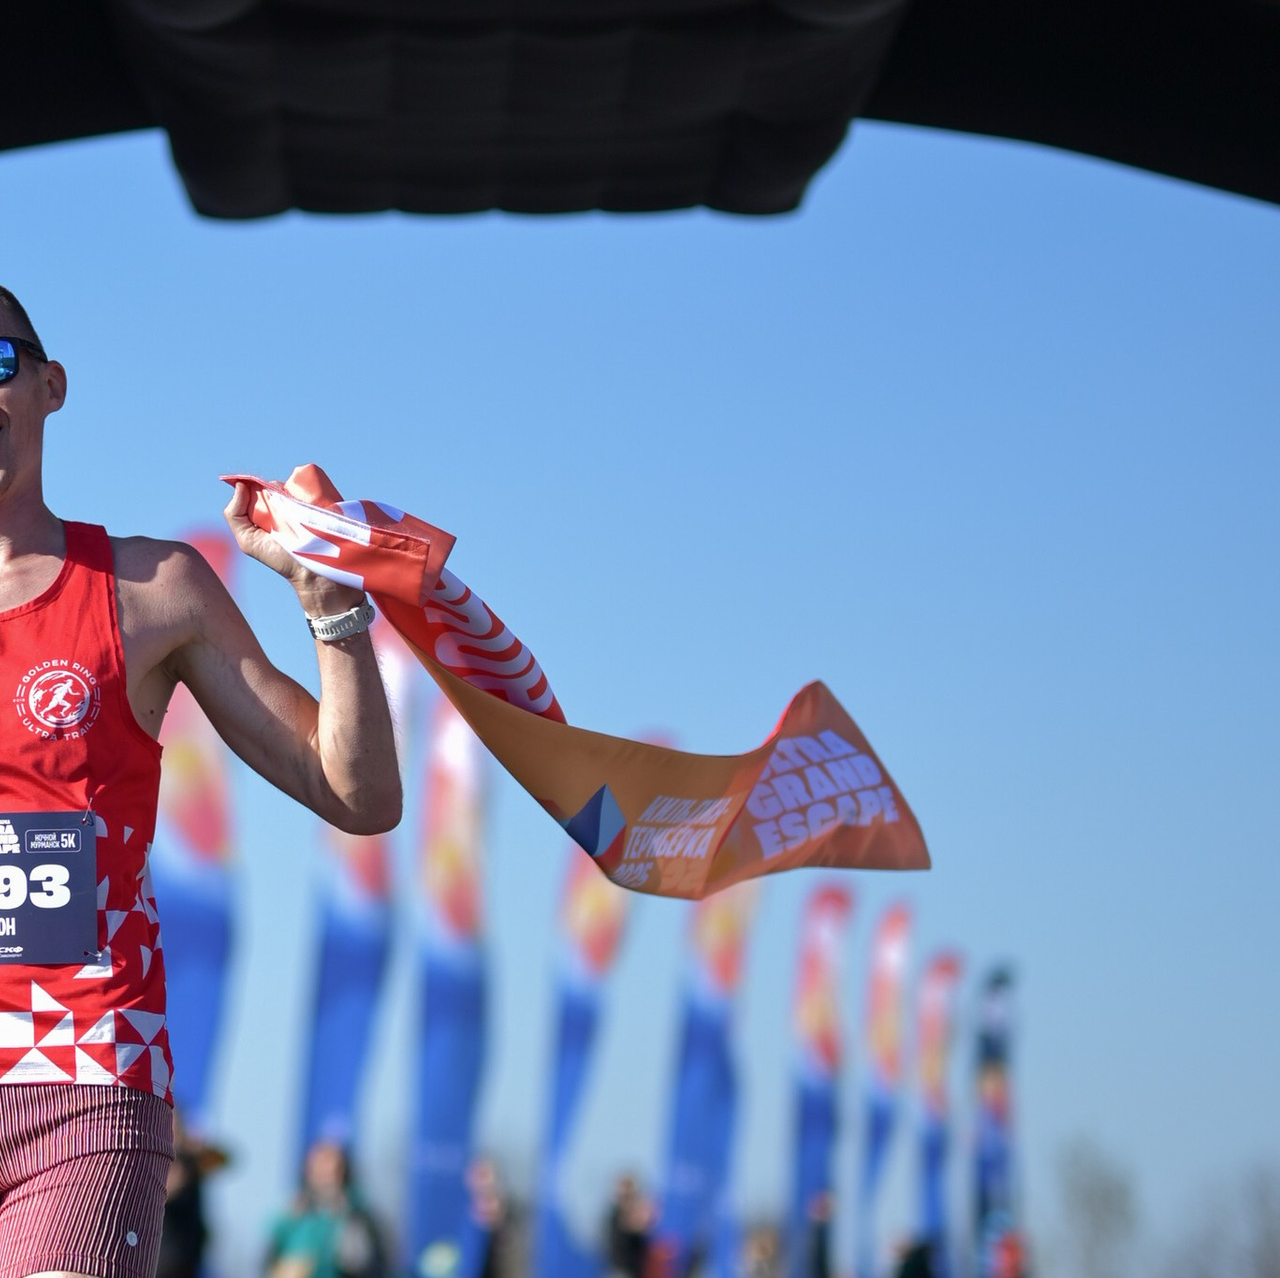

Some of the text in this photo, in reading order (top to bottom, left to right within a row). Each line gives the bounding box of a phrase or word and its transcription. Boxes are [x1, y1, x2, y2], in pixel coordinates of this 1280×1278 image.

[22, 659, 97, 685] GOLDEN RING
[22, 717, 94, 741] ULTRA TRAIL
[759, 728, 859, 782] LTRA
[746, 753, 883, 820] GRAND
[752, 785, 901, 861] ESCAPE
